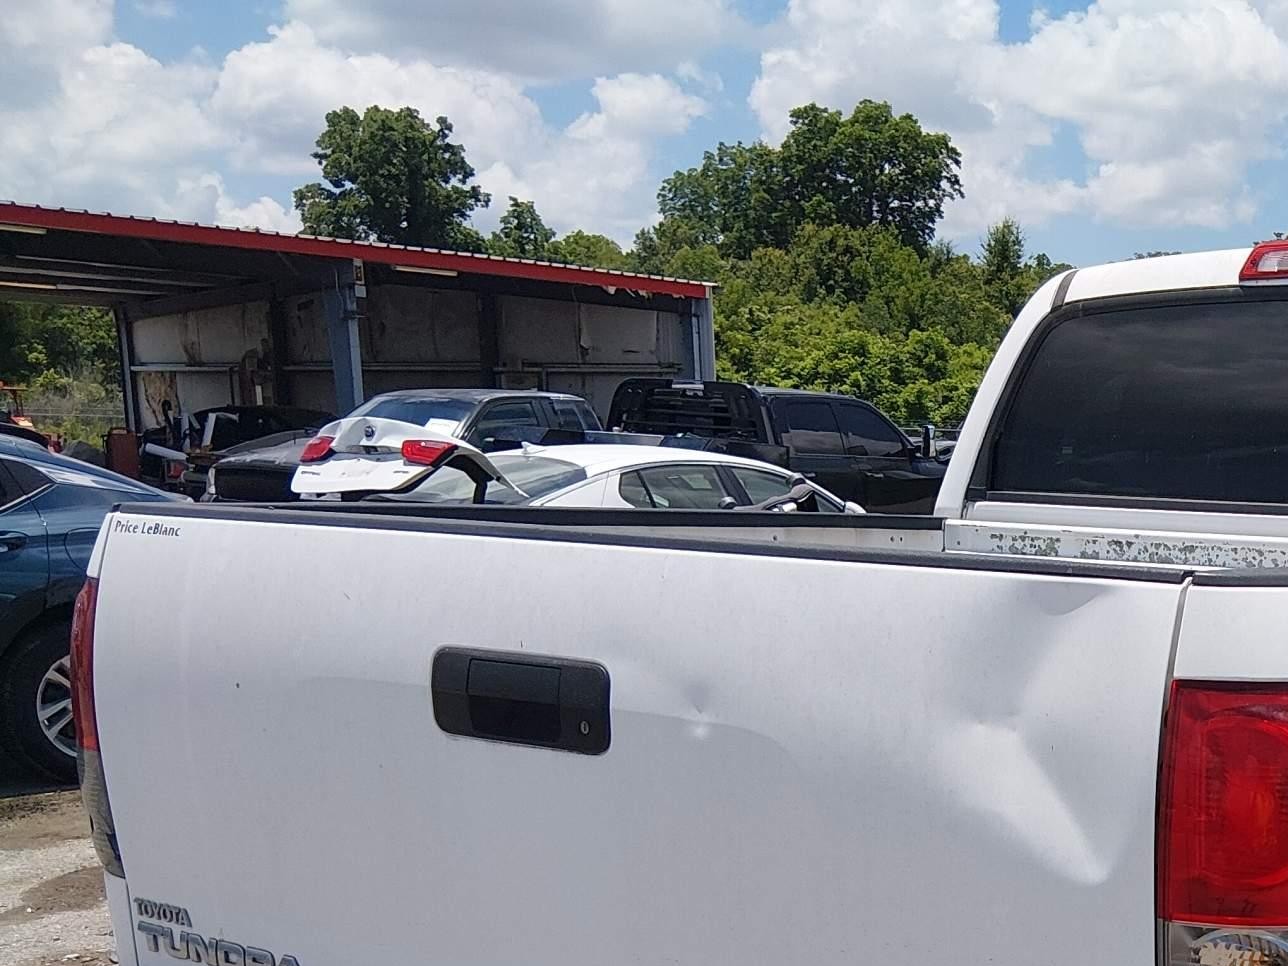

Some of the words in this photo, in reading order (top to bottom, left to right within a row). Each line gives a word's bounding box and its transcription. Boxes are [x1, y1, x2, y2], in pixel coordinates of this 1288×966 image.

[113, 519, 138, 534] Price
[141, 520, 181, 537] LeBlanc
[133, 897, 193, 928] TOYOTA
